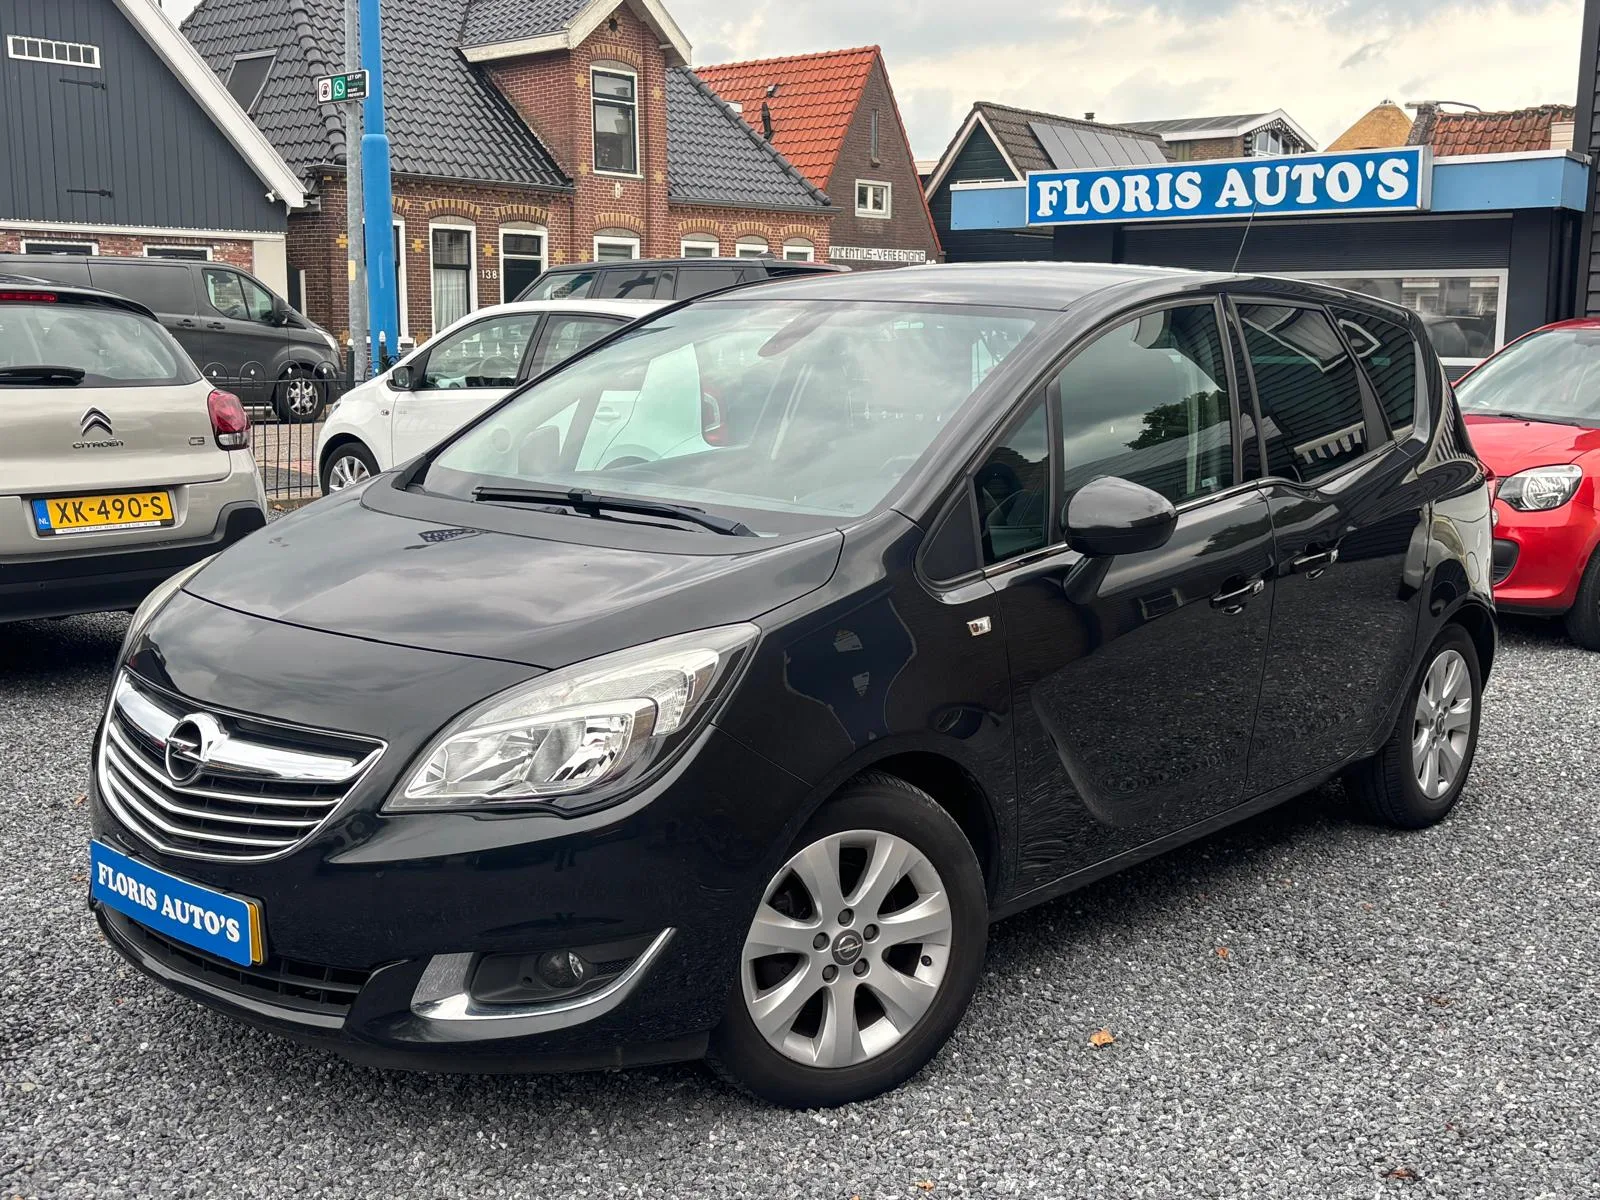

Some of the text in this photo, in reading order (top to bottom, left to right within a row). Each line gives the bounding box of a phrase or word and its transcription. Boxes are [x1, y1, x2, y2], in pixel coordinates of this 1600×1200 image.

[1036, 158, 1409, 216] FLORIS AUTO'S
[481, 269, 498, 279] 138
[188, 436, 205, 446] C3
[55, 496, 164, 524] XK-490-S
[97, 861, 241, 943] FLORIS AUTO'S
